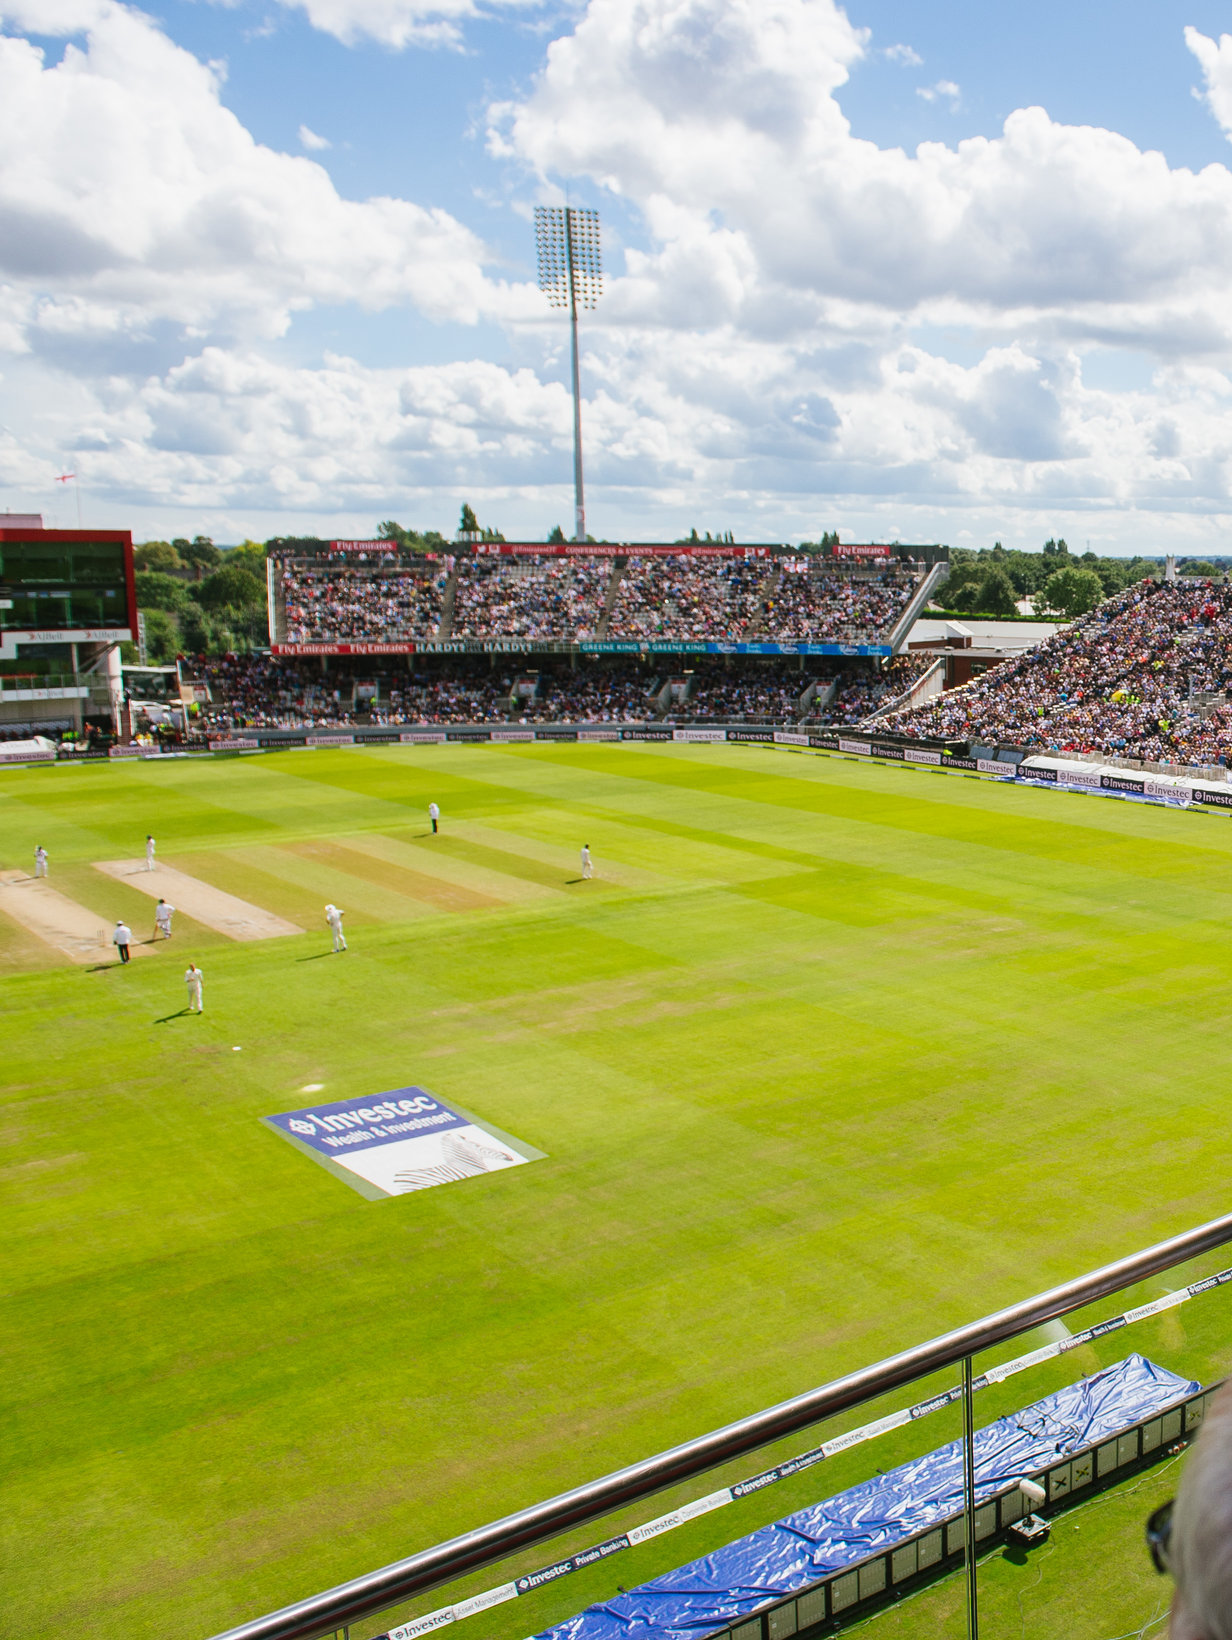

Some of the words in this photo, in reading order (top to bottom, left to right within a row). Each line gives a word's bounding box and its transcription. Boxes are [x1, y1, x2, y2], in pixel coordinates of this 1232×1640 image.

[337, 541, 352, 551] Fly
[353, 541, 392, 550] Emirates
[838, 546, 851, 555] Fly
[852, 546, 886, 554] Emirates
[279, 644, 295, 655] Fly
[297, 644, 339, 653] Emirates
[350, 643, 366, 654] Fly
[368, 643, 409, 652] Emirates
[416, 643, 465, 652] HARDYS
[484, 643, 532, 652] HARDYS
[686, 643, 706, 651] KING
[685, 732, 723, 740] Investec
[736, 732, 773, 740] Investec
[783, 734, 808, 744] Investec
[816, 740, 839, 749] Investec
[847, 743, 870, 754] Investec
[878, 746, 904, 759] Investec
[912, 752, 939, 764] Investec
[948, 756, 976, 769] Investec
[986, 762, 1014, 775] Investec
[1024, 767, 1056, 780] Investec
[1066, 772, 1099, 786] Investec
[1108, 778, 1143, 792] Investec
[1154, 784, 1190, 798] Investec
[306, 1096, 438, 1133] Investec
[322, 1128, 375, 1148] Wealth
[374, 1125, 388, 1138] &
[385, 1111, 457, 1136] Investment
[919, 1395, 949, 1415] Investec
[832, 1430, 865, 1450] Investec
[742, 1471, 778, 1494] Investec
[640, 1516, 680, 1538] Investec
[528, 1562, 572, 1586] Investec
[575, 1550, 600, 1566] Private
[600, 1538, 629, 1556] Banking
[404, 1612, 451, 1638] Investec
[456, 1603, 475, 1616] Asset
[475, 1587, 514, 1608] Management
